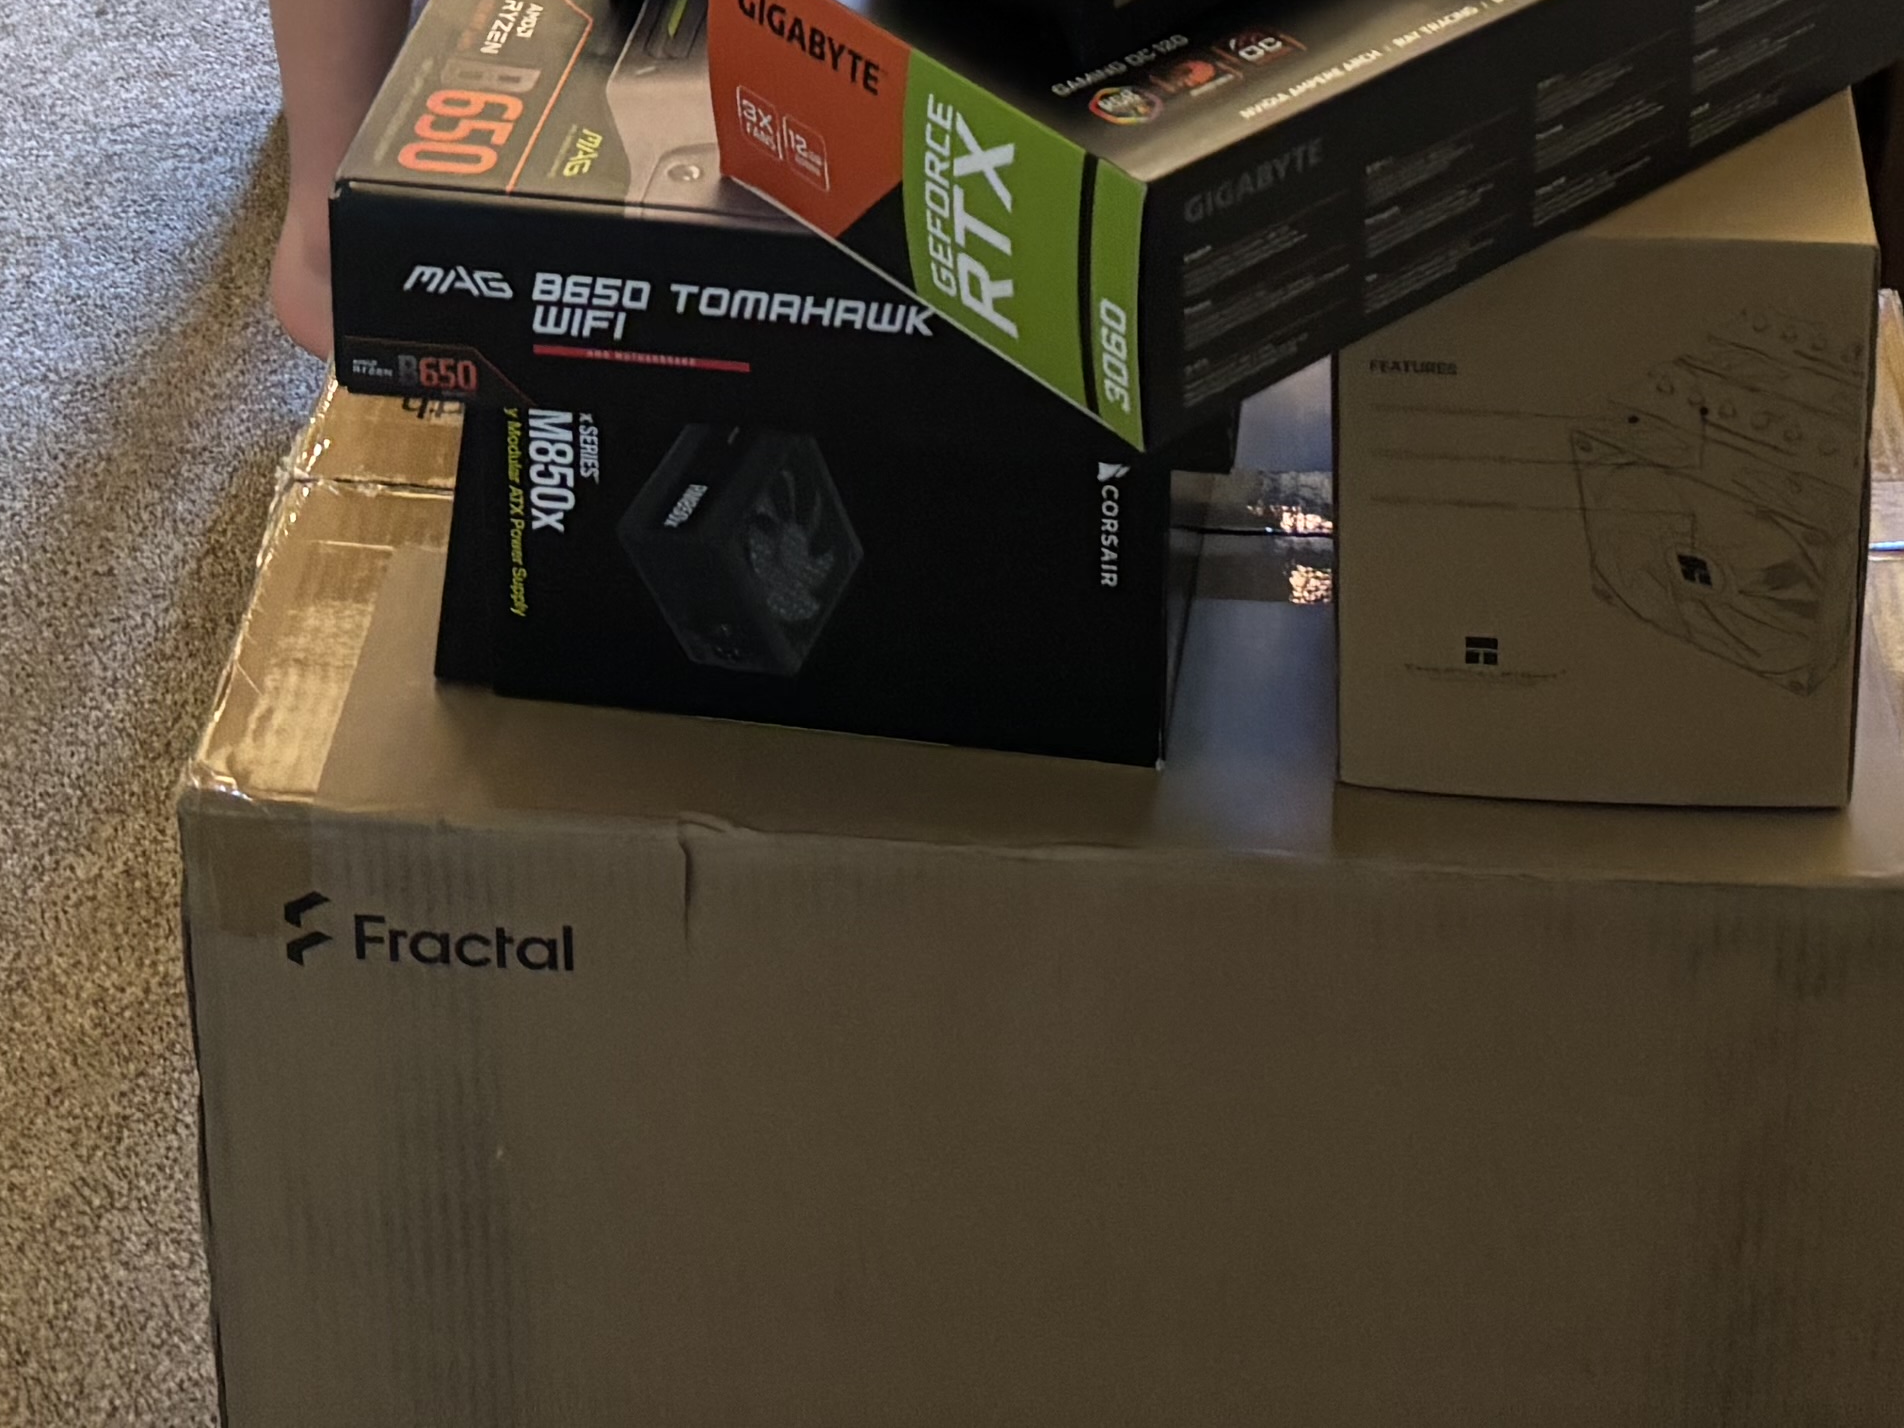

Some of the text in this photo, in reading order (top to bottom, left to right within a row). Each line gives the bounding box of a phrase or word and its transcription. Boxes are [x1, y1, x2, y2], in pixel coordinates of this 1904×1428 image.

[480, 0, 524, 54] RYZEN
[924, 93, 958, 296] GEFORCE
[1183, 137, 1325, 224] GIGABYTE
[953, 112, 1020, 340] RTX
[403, 265, 935, 337] MAG B650 TOMAHAWK
[532, 305, 628, 341] WIFI
[397, 354, 479, 392] B650
[1100, 298, 1131, 413] 3060
[1368, 358, 1459, 377] FEATURES
[507, 421, 522, 484] Modular
[578, 425, 599, 480] SERIES
[509, 484, 525, 516] ATX
[510, 518, 526, 566] Power
[1100, 484, 1119, 587] CORSAIR
[510, 567, 529, 618] Supply
[353, 913, 575, 972] Fractal
